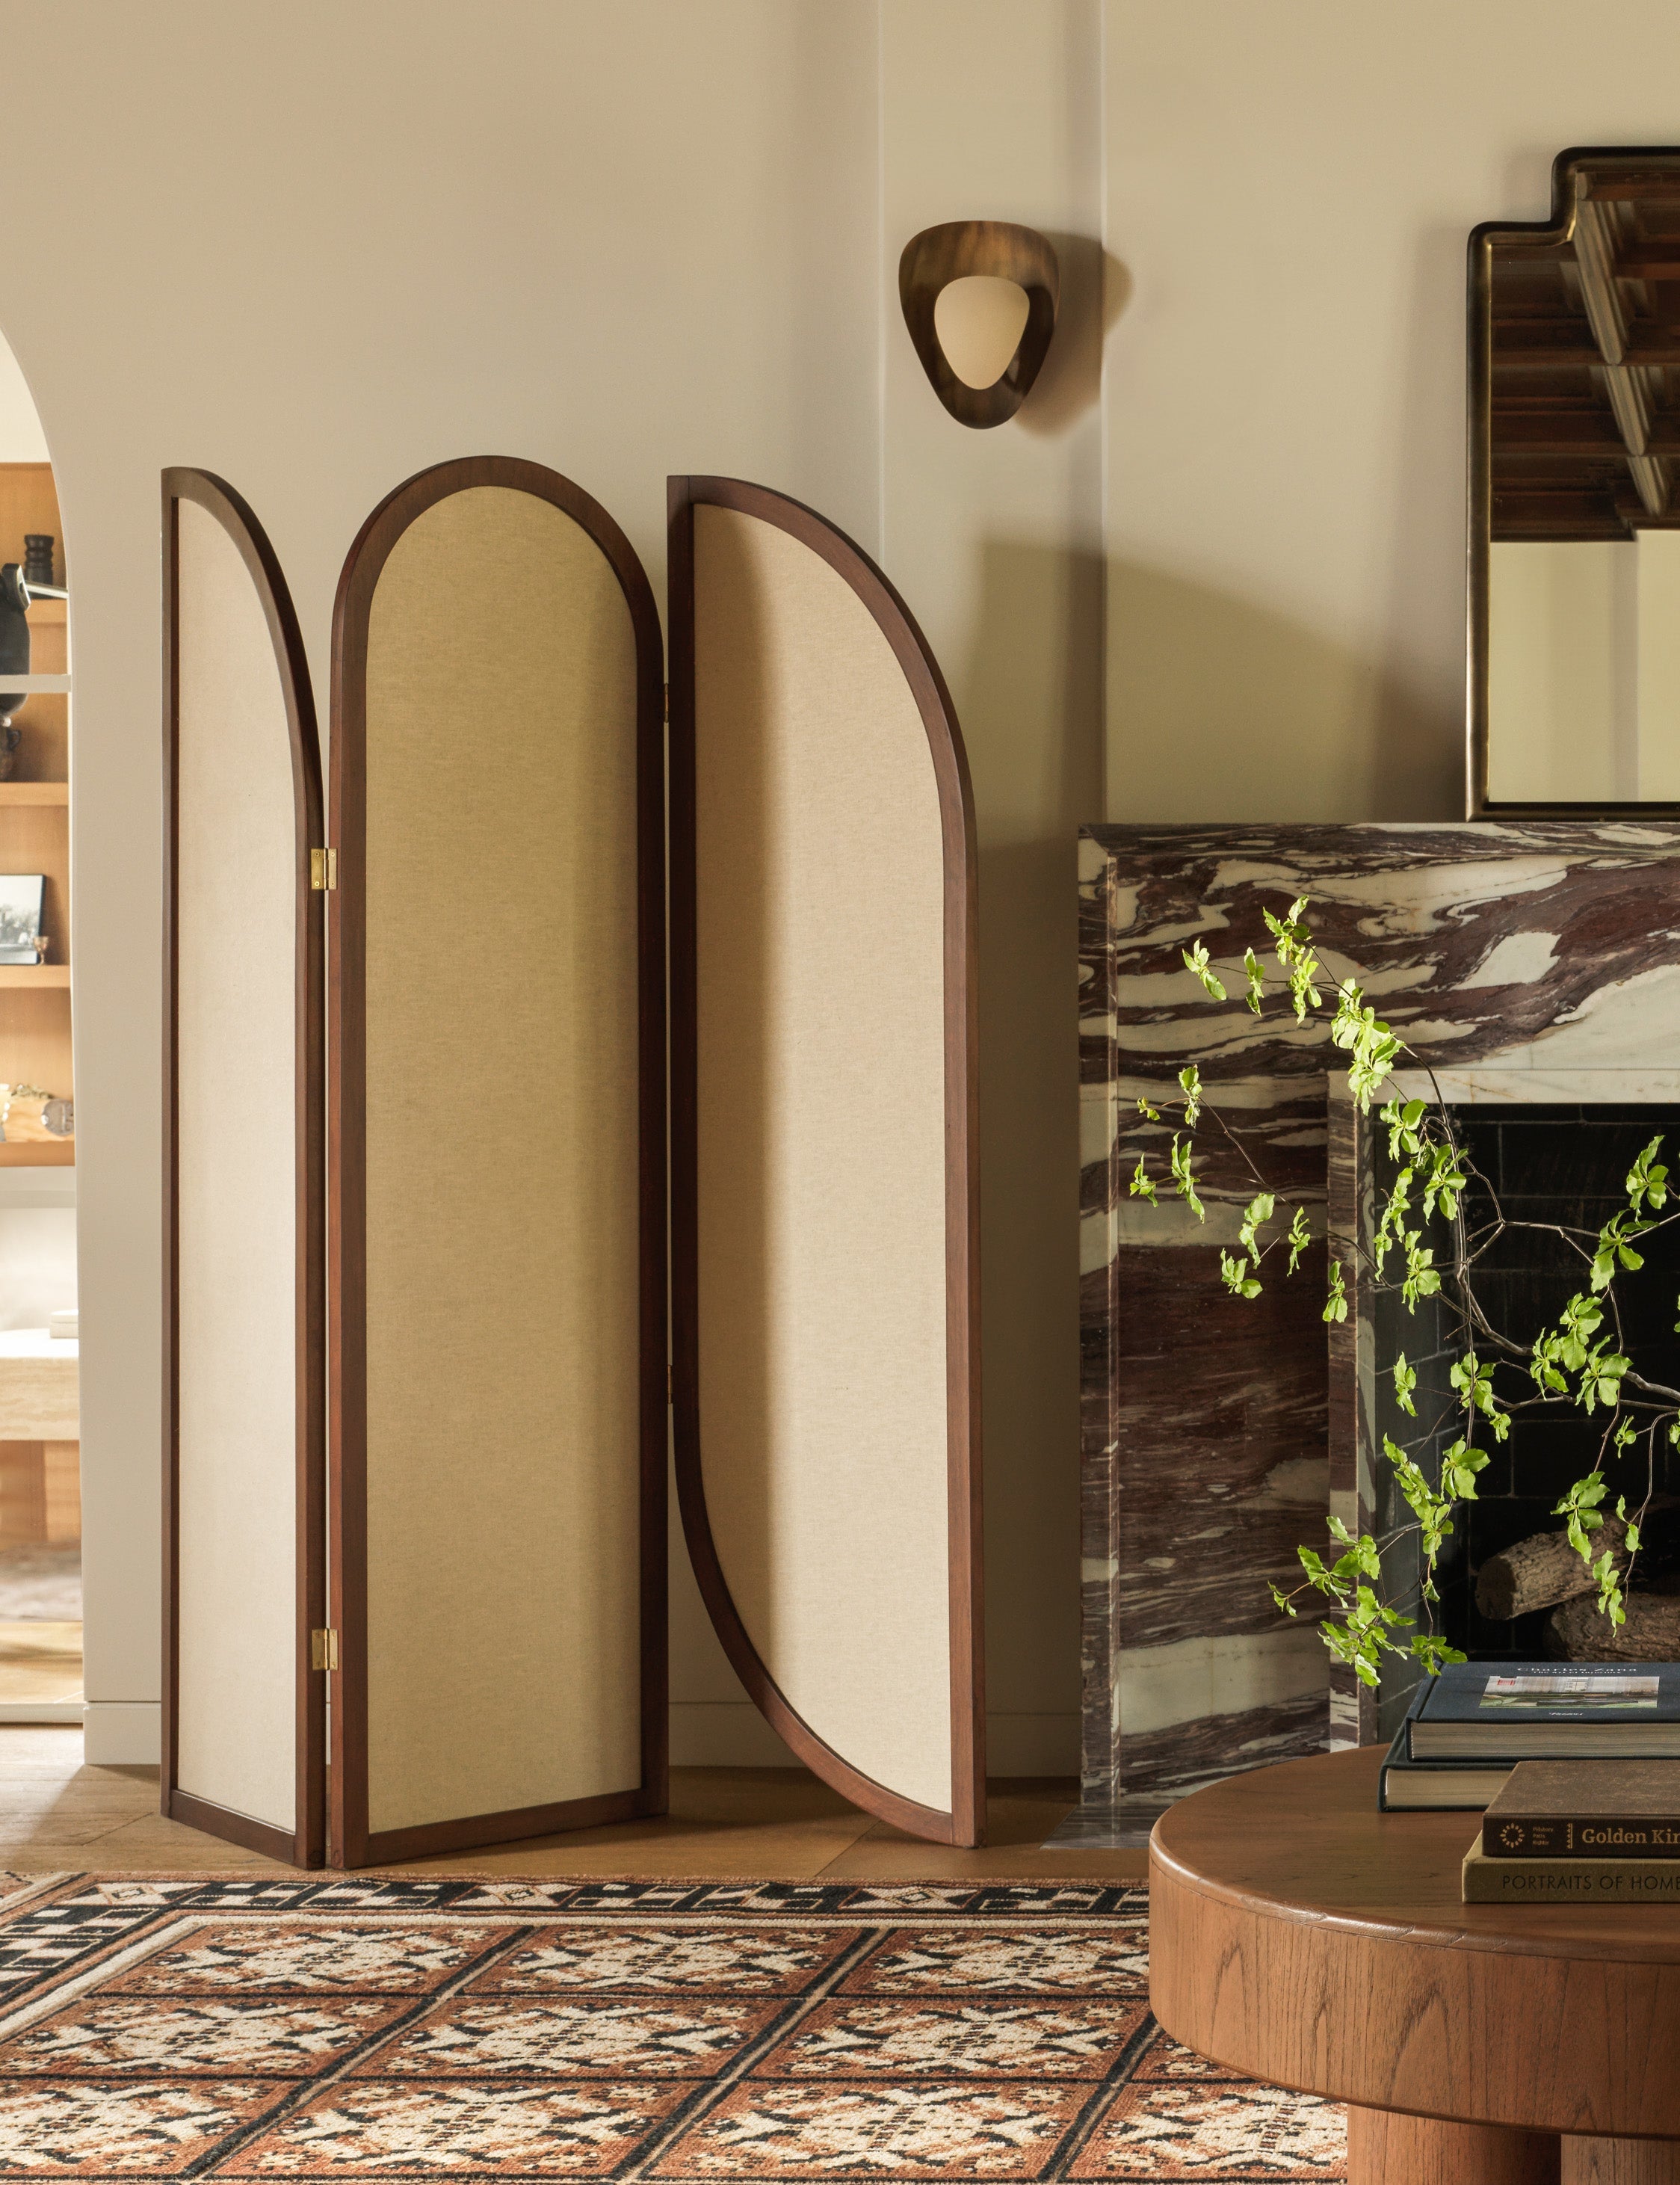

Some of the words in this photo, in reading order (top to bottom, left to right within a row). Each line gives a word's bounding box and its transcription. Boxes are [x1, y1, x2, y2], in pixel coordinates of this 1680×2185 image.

[1582, 1828, 1648, 1843] Golden
[1502, 1875, 1592, 1890] PORTRAITS
[1599, 1875, 1623, 1890] OF
